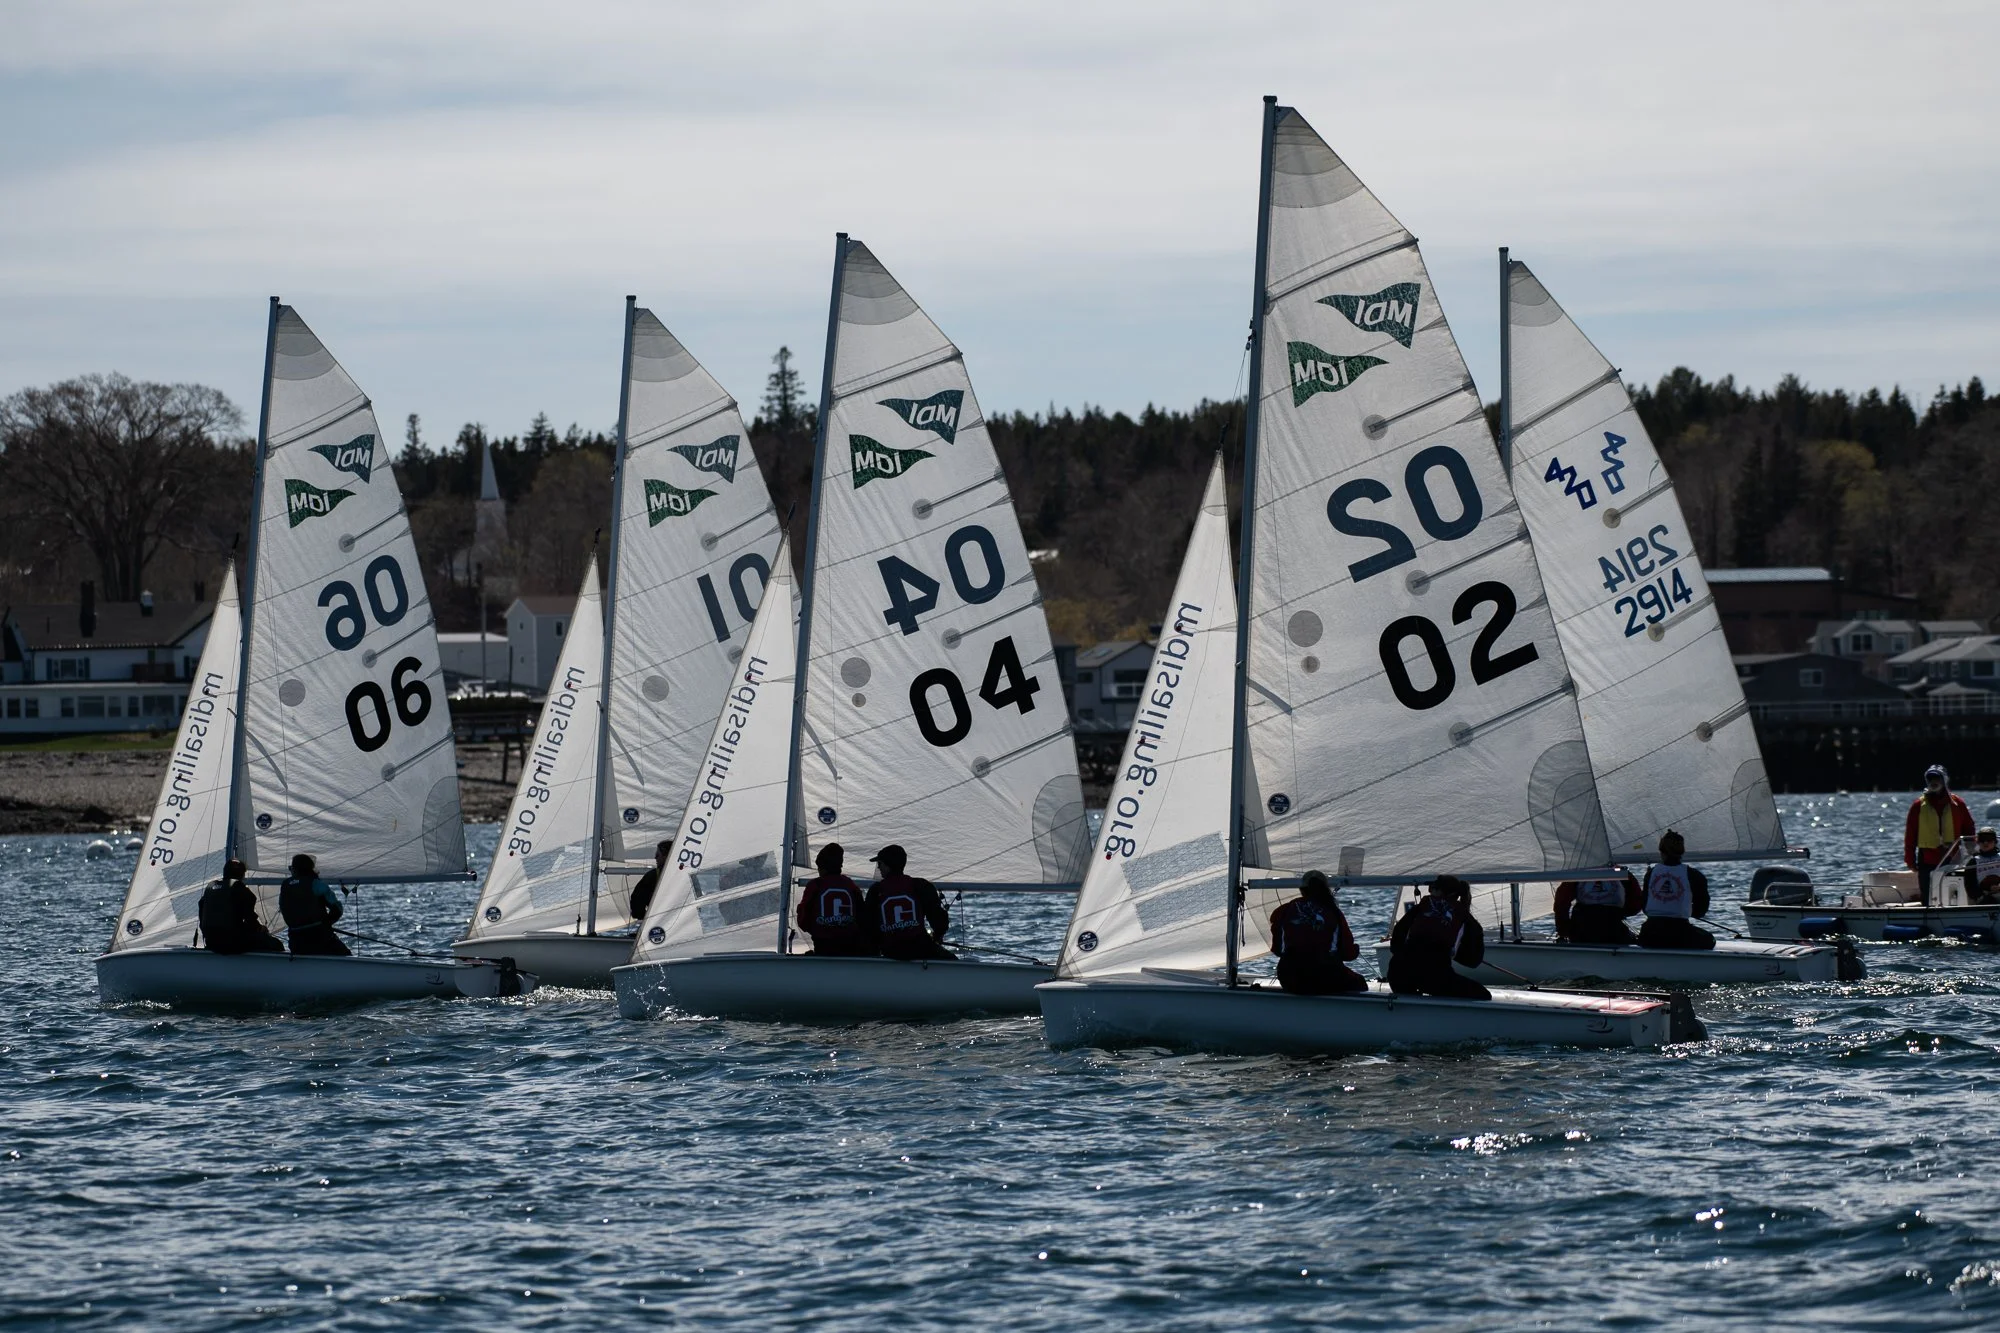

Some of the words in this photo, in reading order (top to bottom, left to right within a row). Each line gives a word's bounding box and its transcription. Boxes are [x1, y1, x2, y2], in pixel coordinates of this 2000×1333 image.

[1294, 360, 1349, 386] MDI
[855, 450, 902, 475] MDI
[1544, 457, 1597, 510] 420
[290, 491, 331, 514] MDI
[650, 491, 691, 513] MDI
[1614, 567, 1693, 638] 2914
[1378, 580, 1540, 711] 02
[345, 656, 432, 752] 06
[909, 635, 1041, 748] 04
